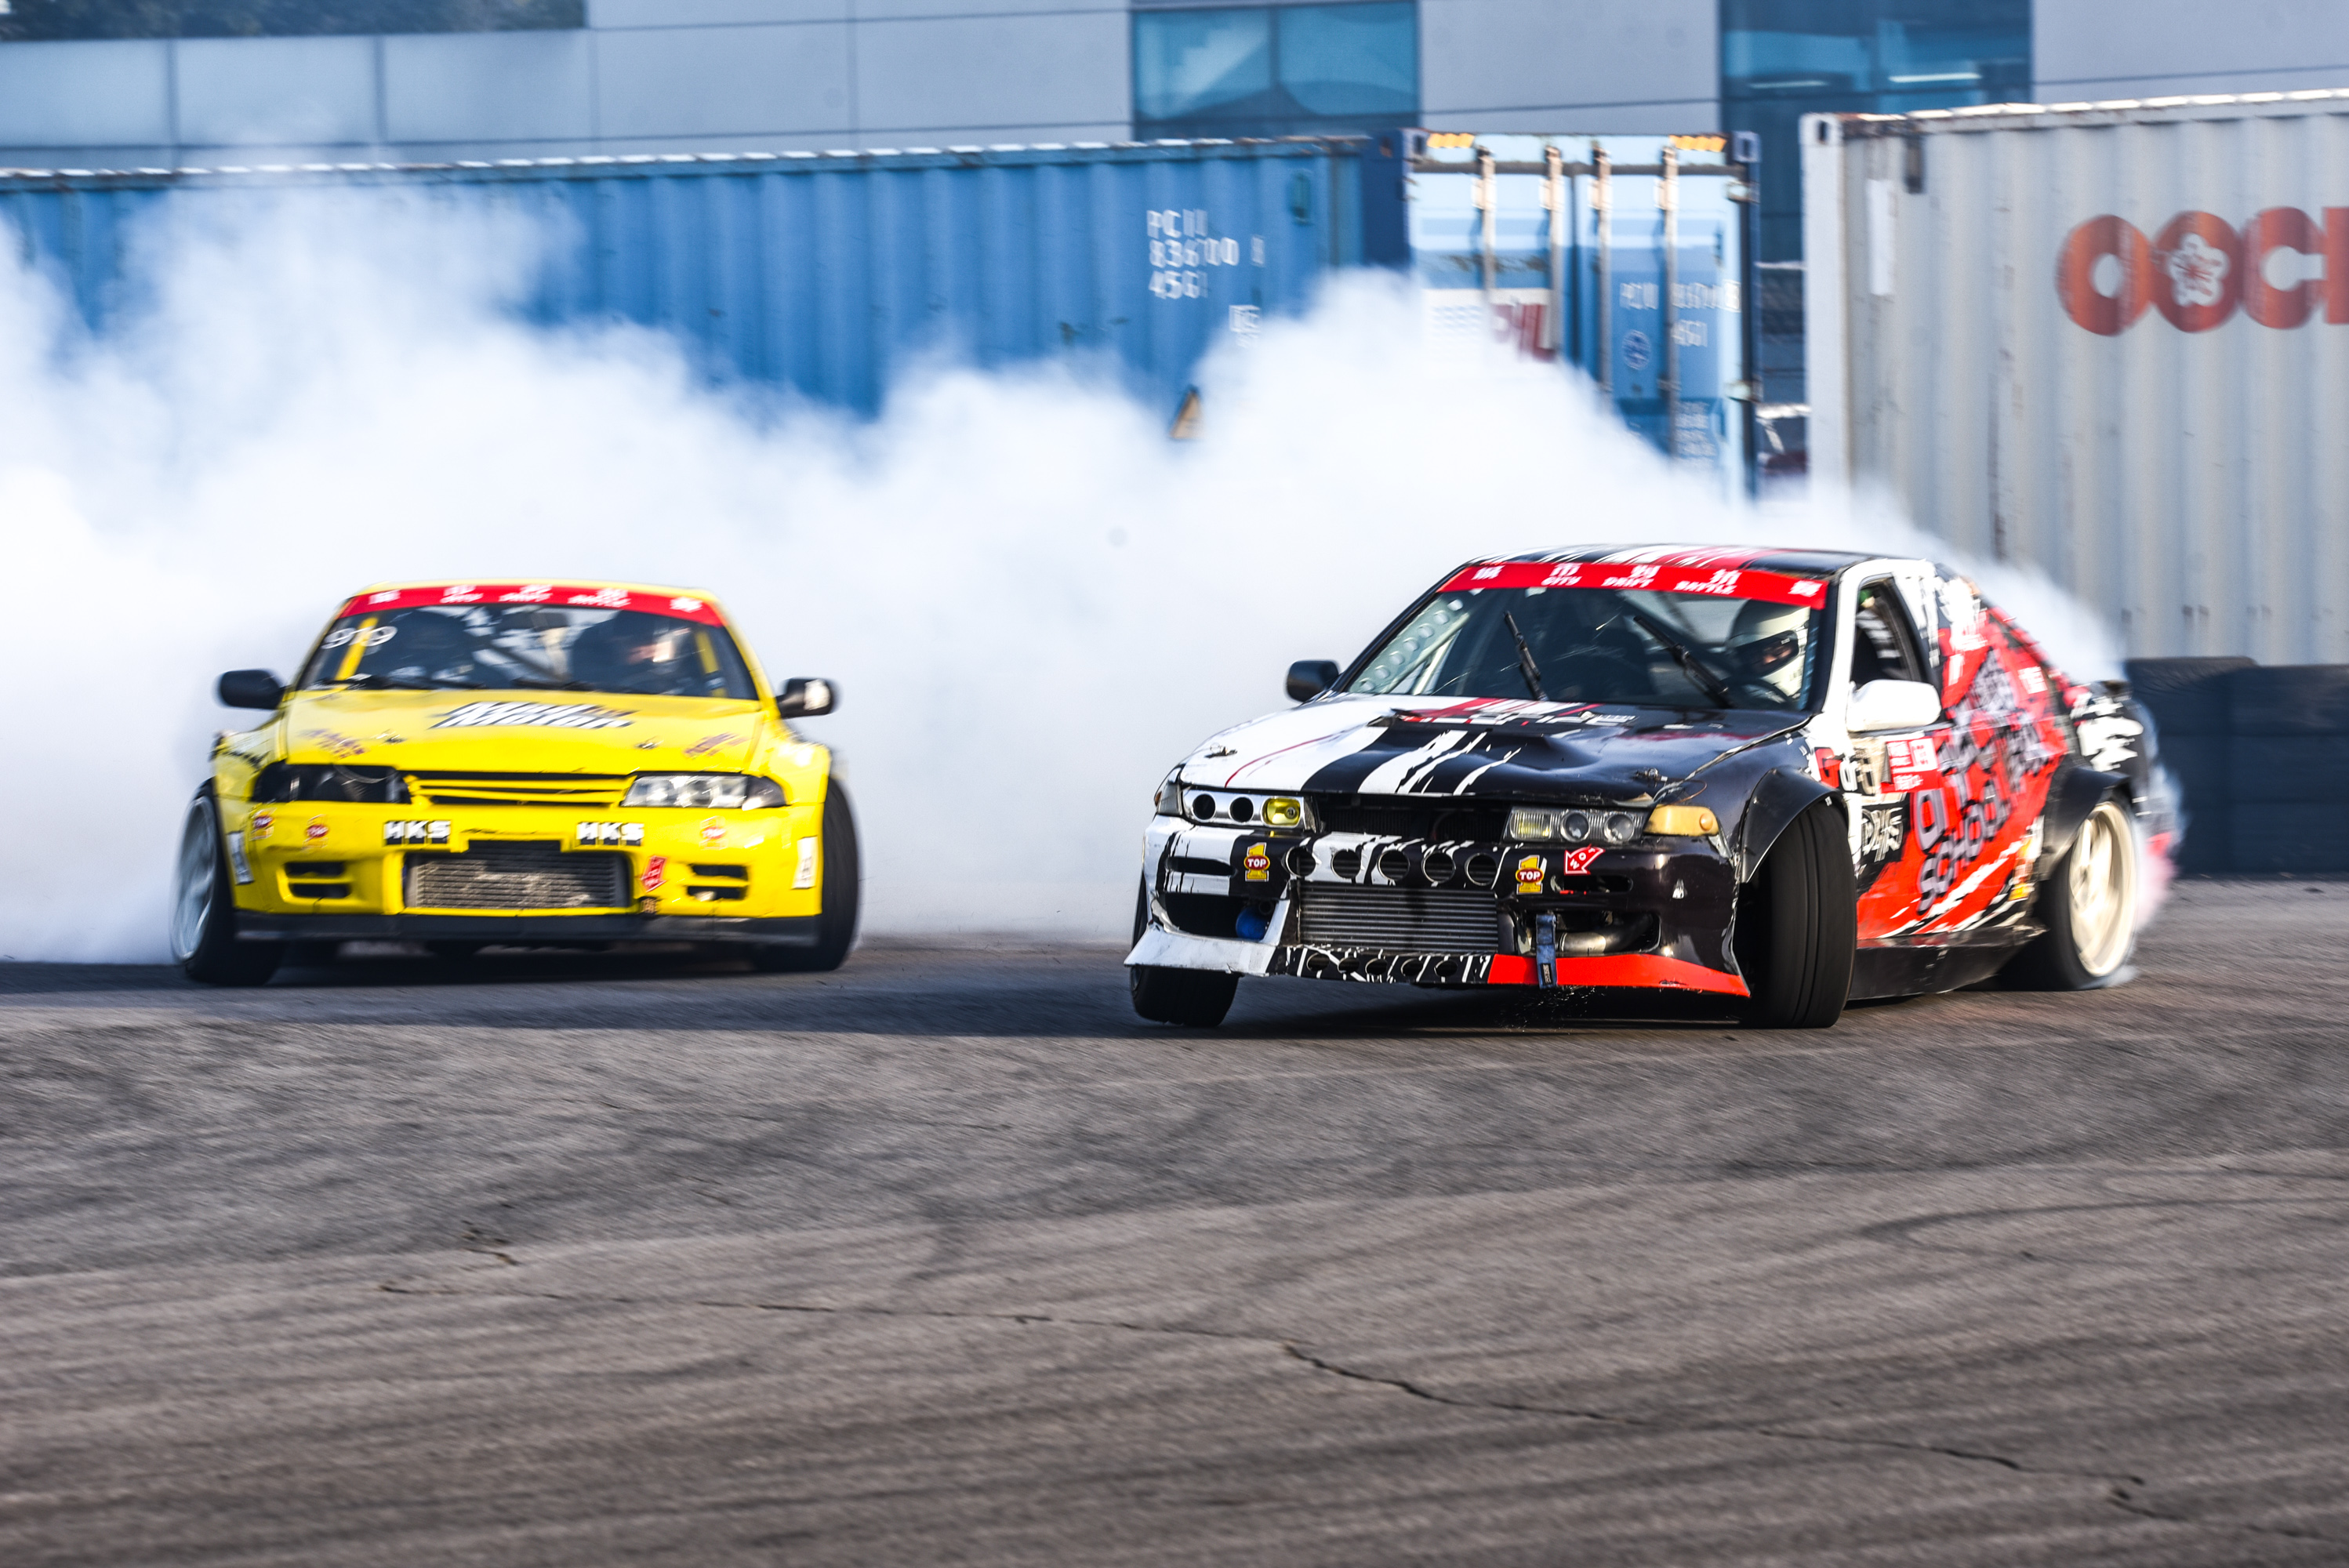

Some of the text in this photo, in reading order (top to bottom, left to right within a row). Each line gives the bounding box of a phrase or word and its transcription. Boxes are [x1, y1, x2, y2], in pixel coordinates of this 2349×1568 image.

[1541, 576, 1582, 586] CITY
[383, 820, 451, 841] HKS
[576, 822, 644, 842] HKS
[1247, 858, 1267, 868] TOP
[1519, 871, 1541, 880] TOP
